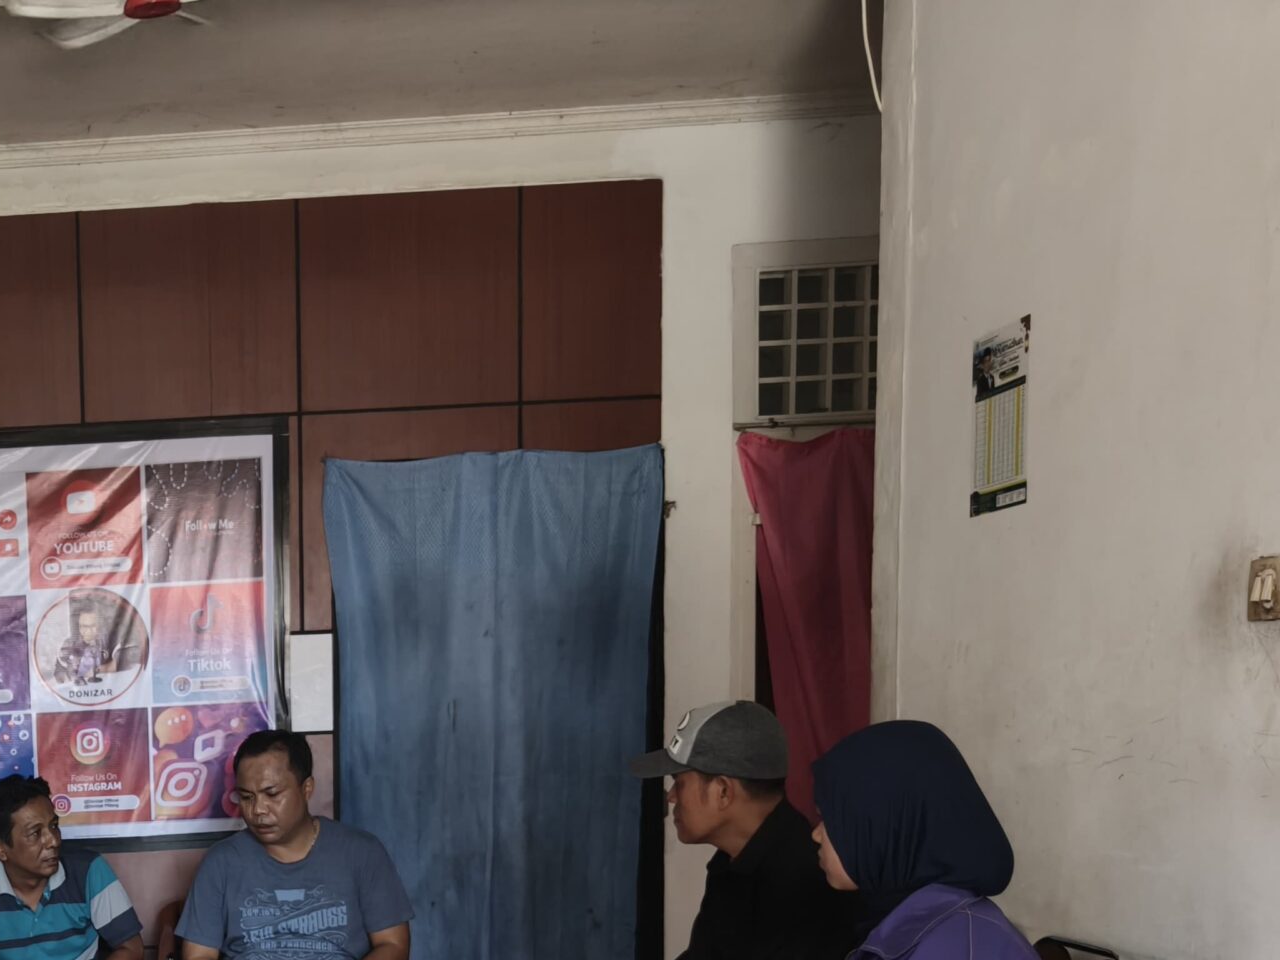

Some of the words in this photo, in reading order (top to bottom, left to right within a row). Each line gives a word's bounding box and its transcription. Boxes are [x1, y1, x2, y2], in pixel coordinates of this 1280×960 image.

[54, 541, 113, 554] YOUTUBE
[187, 657, 232, 672] Tiktok
[69, 689, 113, 698] DONIZAR
[71, 774, 95, 782] Follow
[95, 773, 106, 781] Us
[106, 772, 117, 780] On
[67, 782, 122, 792] INSTAGRAM
[278, 906, 347, 935] STRAUSS
